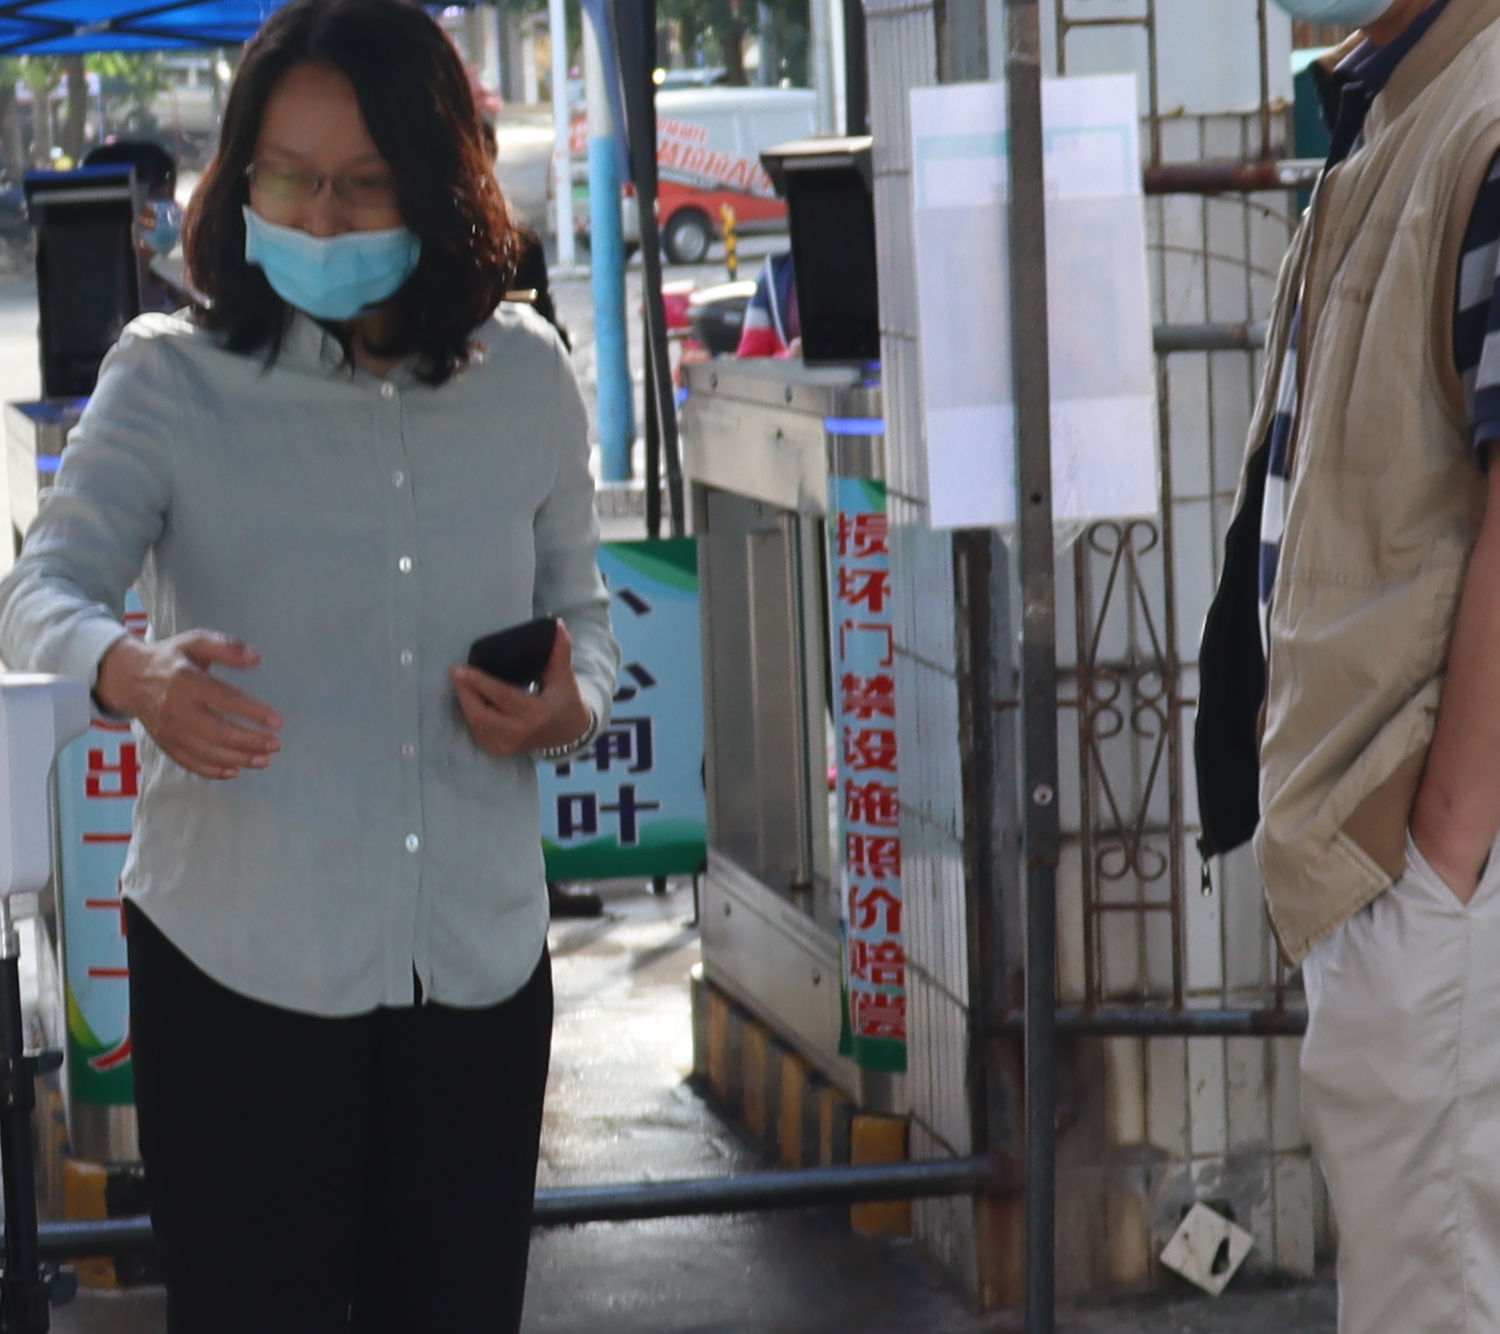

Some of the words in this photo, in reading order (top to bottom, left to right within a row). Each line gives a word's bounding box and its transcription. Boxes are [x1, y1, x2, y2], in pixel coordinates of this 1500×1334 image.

[836, 511, 907, 1040] 损坏门禁设施照价赔偿
